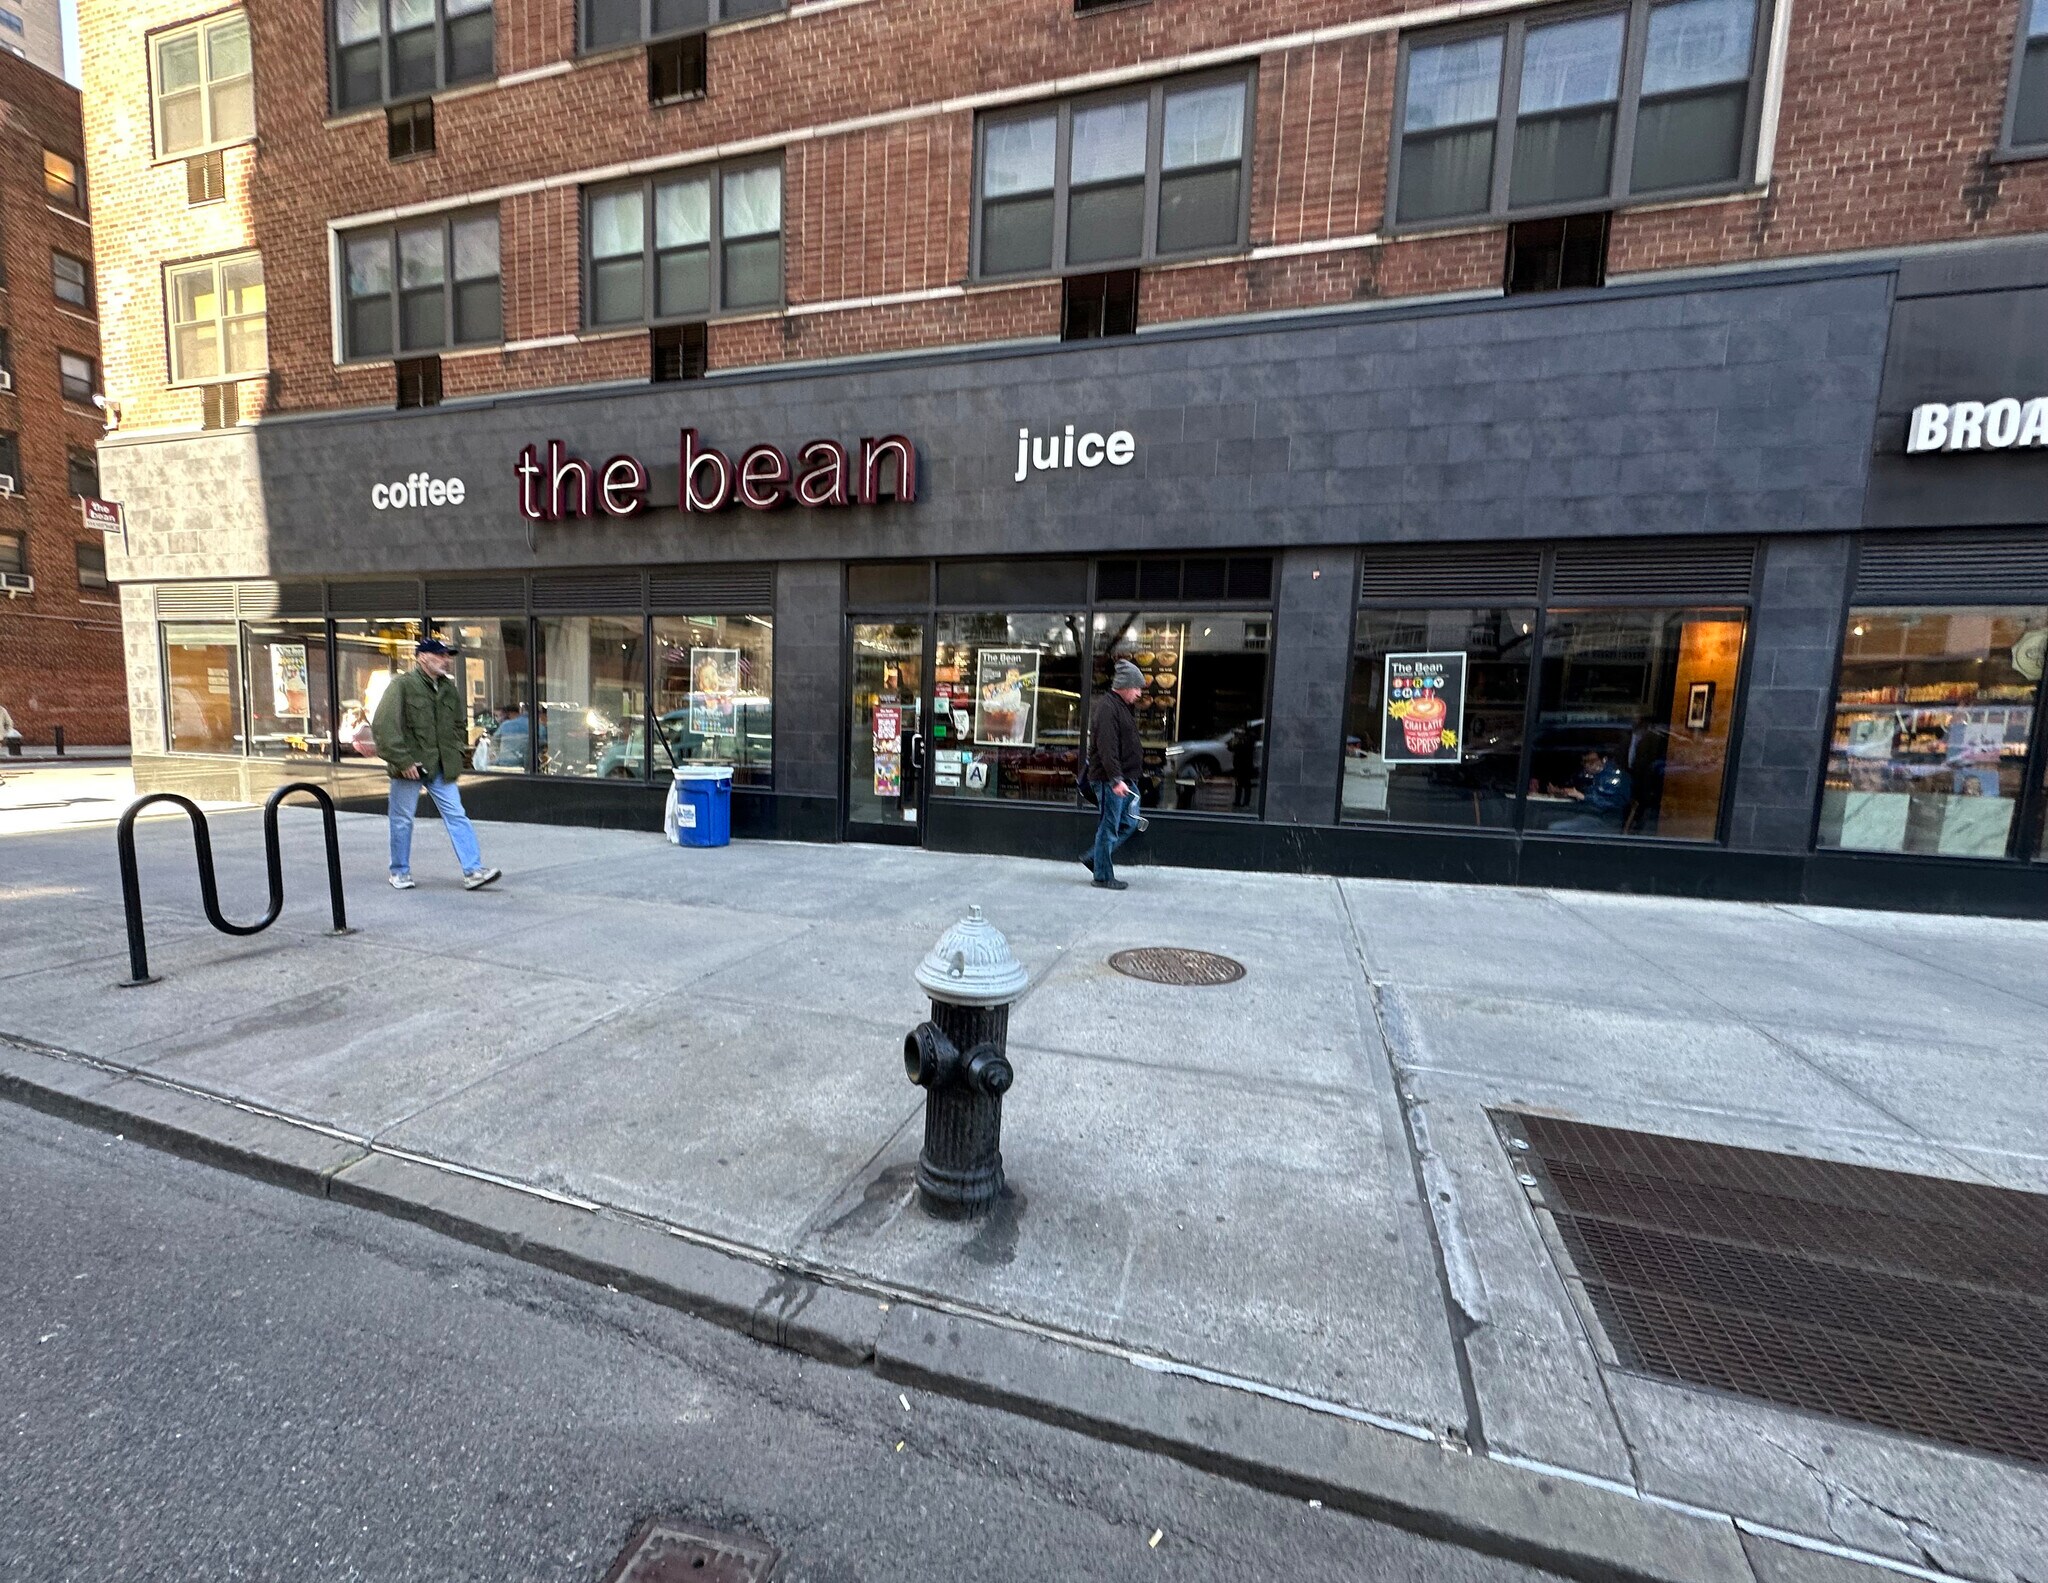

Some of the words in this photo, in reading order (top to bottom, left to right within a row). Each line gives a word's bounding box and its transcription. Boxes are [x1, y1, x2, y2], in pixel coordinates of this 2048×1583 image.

[1015, 425, 1135, 482] juice
[514, 440, 647, 520] the
[681, 427, 916, 513] bean
[371, 472, 465, 510] coffee
[91, 501, 110, 513] the
[89, 509, 116, 522] bean
[982, 653, 998, 661] The
[1000, 653, 1022, 662] Bean
[1391, 662, 1412, 673] The
[1415, 661, 1443, 673] Bean
[969, 766, 983, 782] A
